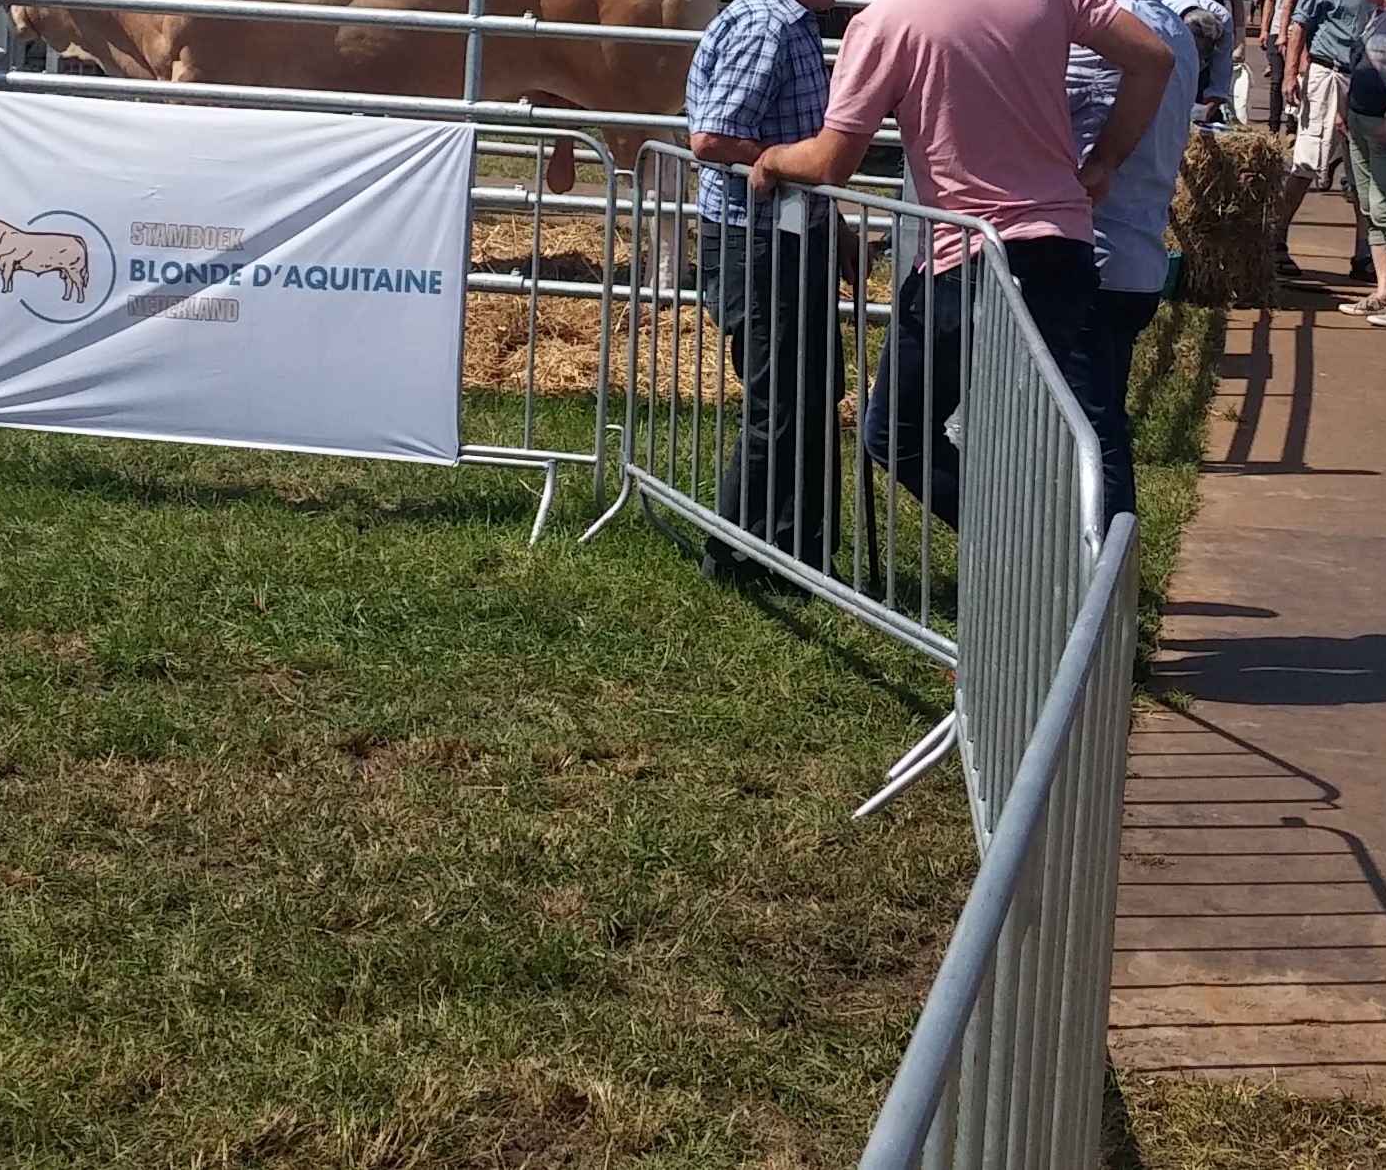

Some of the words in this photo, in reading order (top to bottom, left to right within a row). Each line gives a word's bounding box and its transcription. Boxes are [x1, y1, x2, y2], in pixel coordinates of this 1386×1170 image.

[130, 221, 245, 252] STAMBOEK
[129, 258, 243, 286] BLONDE
[252, 264, 443, 295] D'AQUITAINE
[127, 294, 240, 323] NEDERLAND
